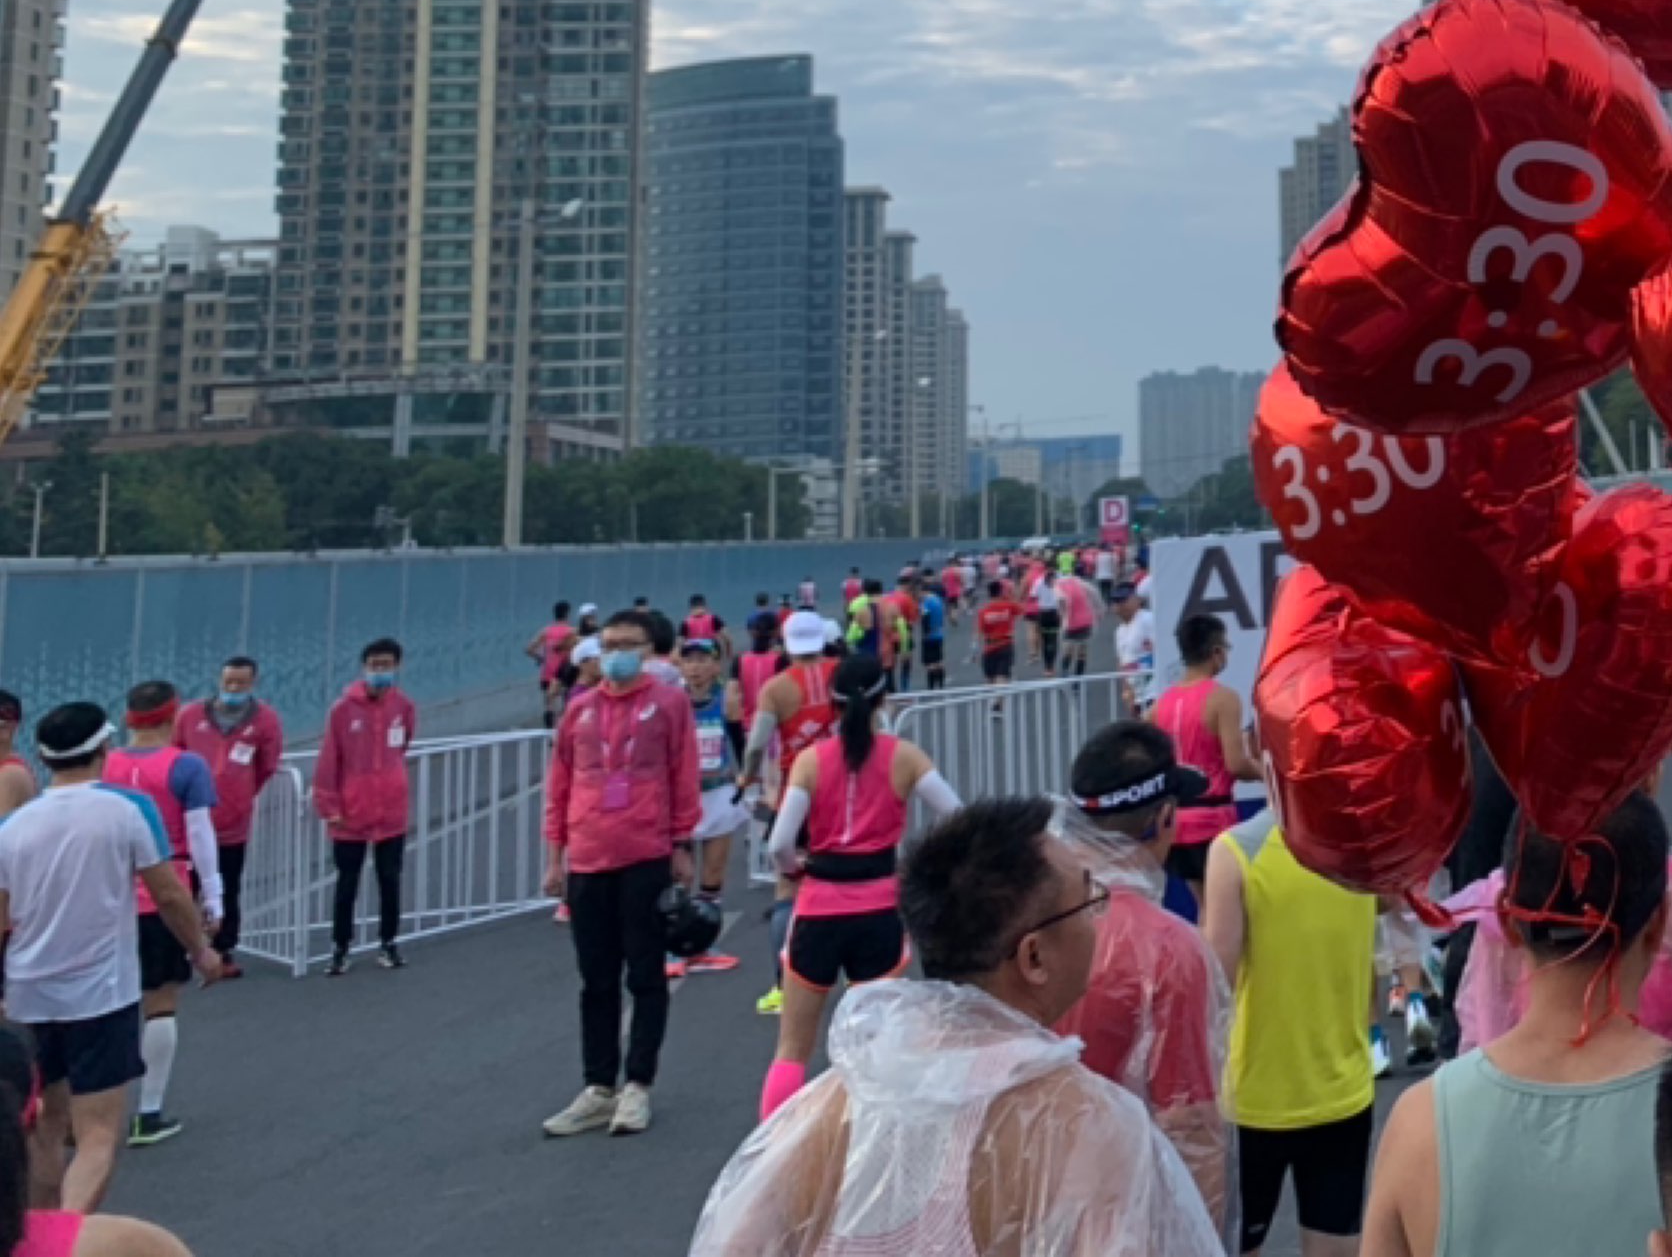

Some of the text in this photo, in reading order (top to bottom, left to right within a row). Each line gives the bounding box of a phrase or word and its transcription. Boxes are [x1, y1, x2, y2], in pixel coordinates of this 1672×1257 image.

[1413, 140, 1610, 403] 3:30
[1103, 499, 1124, 523] D
[1271, 422, 1446, 540] 3:30
